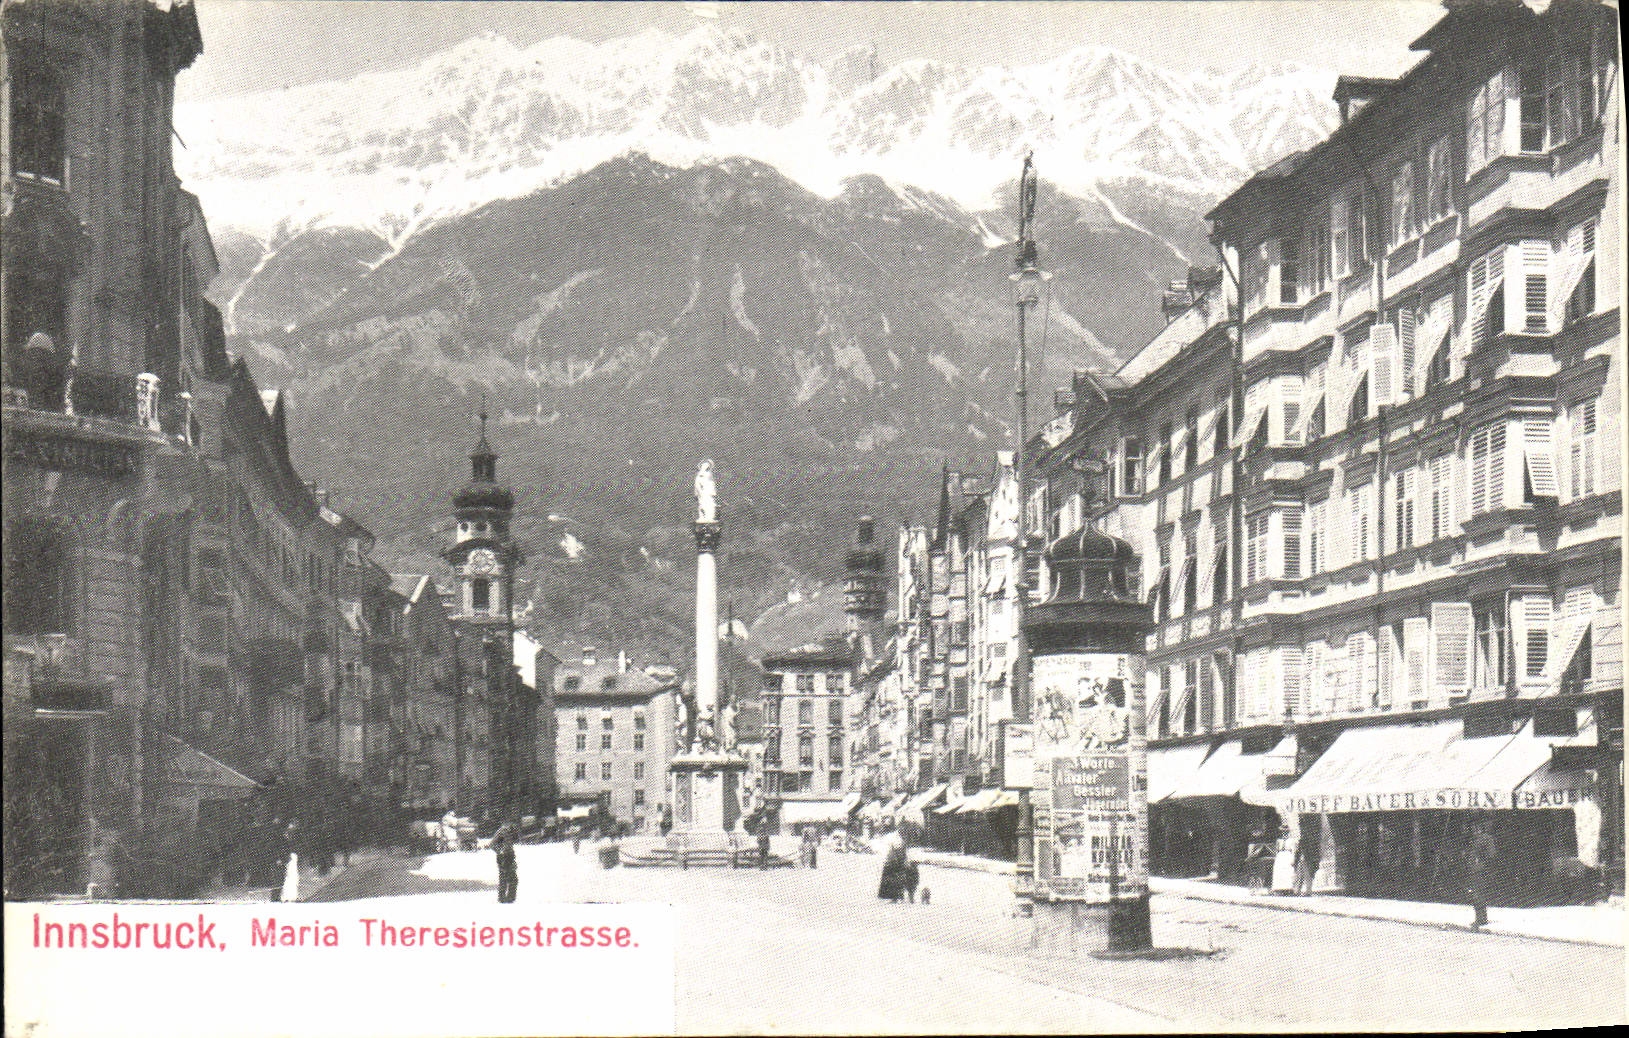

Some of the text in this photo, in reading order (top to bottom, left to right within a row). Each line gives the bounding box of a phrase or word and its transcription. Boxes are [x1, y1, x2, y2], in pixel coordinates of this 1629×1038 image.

[1286, 794, 1343, 813] JOSEF
[1350, 792, 1416, 811] BAUER
[1436, 791, 1499, 808] SOHN
[1525, 790, 1592, 808] BAUER
